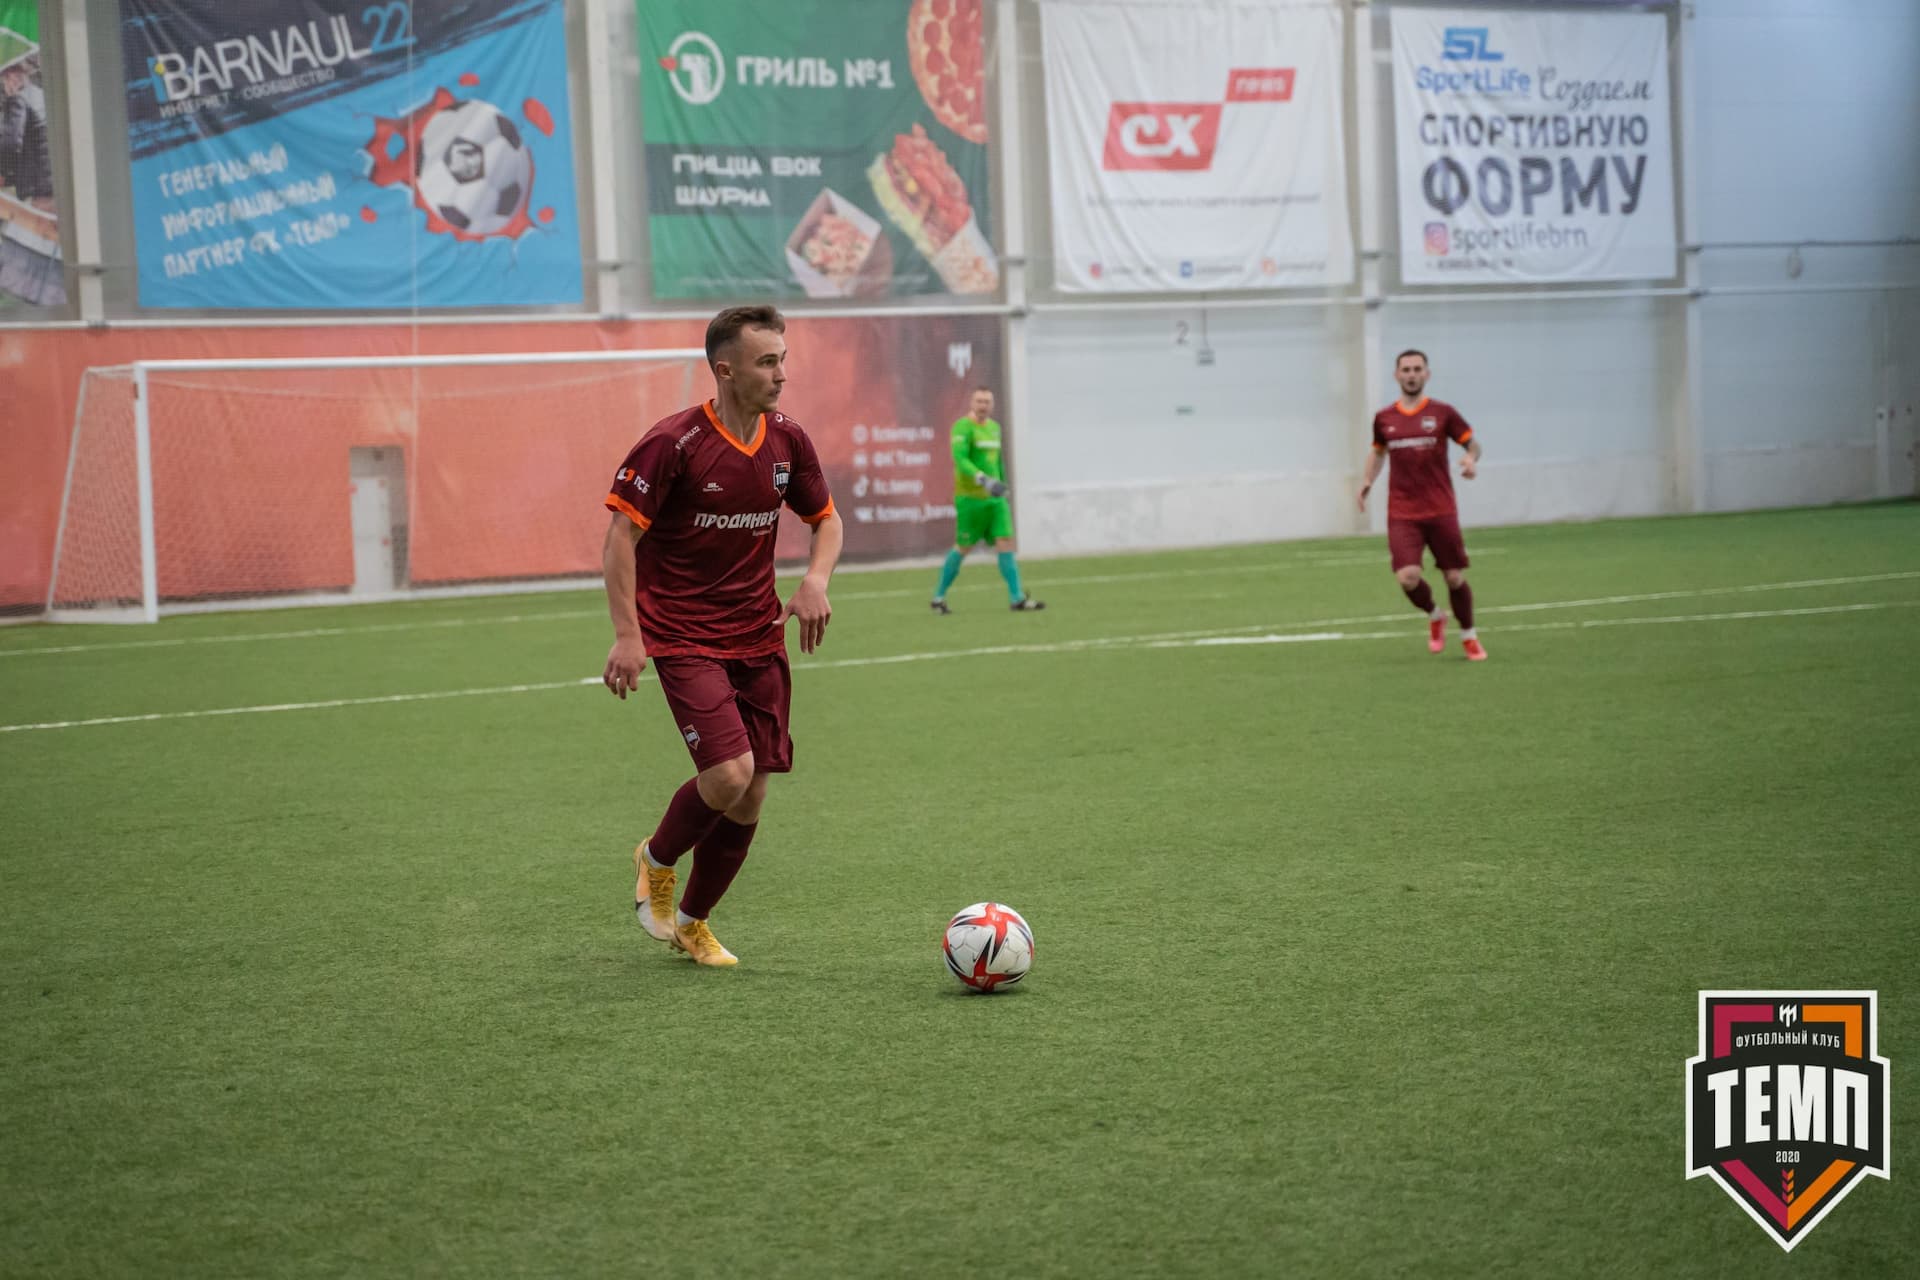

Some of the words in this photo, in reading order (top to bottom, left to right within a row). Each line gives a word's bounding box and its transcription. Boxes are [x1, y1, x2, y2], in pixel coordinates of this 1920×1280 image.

[1441, 27, 1504, 61] SL
[736, 56, 838, 88] ГРИЛЬ
[844, 59, 895, 89] №1
[1416, 66, 1531, 95] SportLife
[1538, 66, 1651, 110] Создаем
[1420, 113, 1649, 147] СПОРТИВНУЮ
[158, 141, 289, 198] ГЕНЕРАЛЬНЫЙ
[673, 155, 762, 176] ПИЦЦА
[770, 157, 821, 176] ВОК
[675, 187, 771, 207] ШАУРМА
[1422, 155, 1648, 216] ФОРМУ
[1453, 222, 1588, 252] sportlifebrn
[163, 237, 246, 278] ПАРТНЕР
